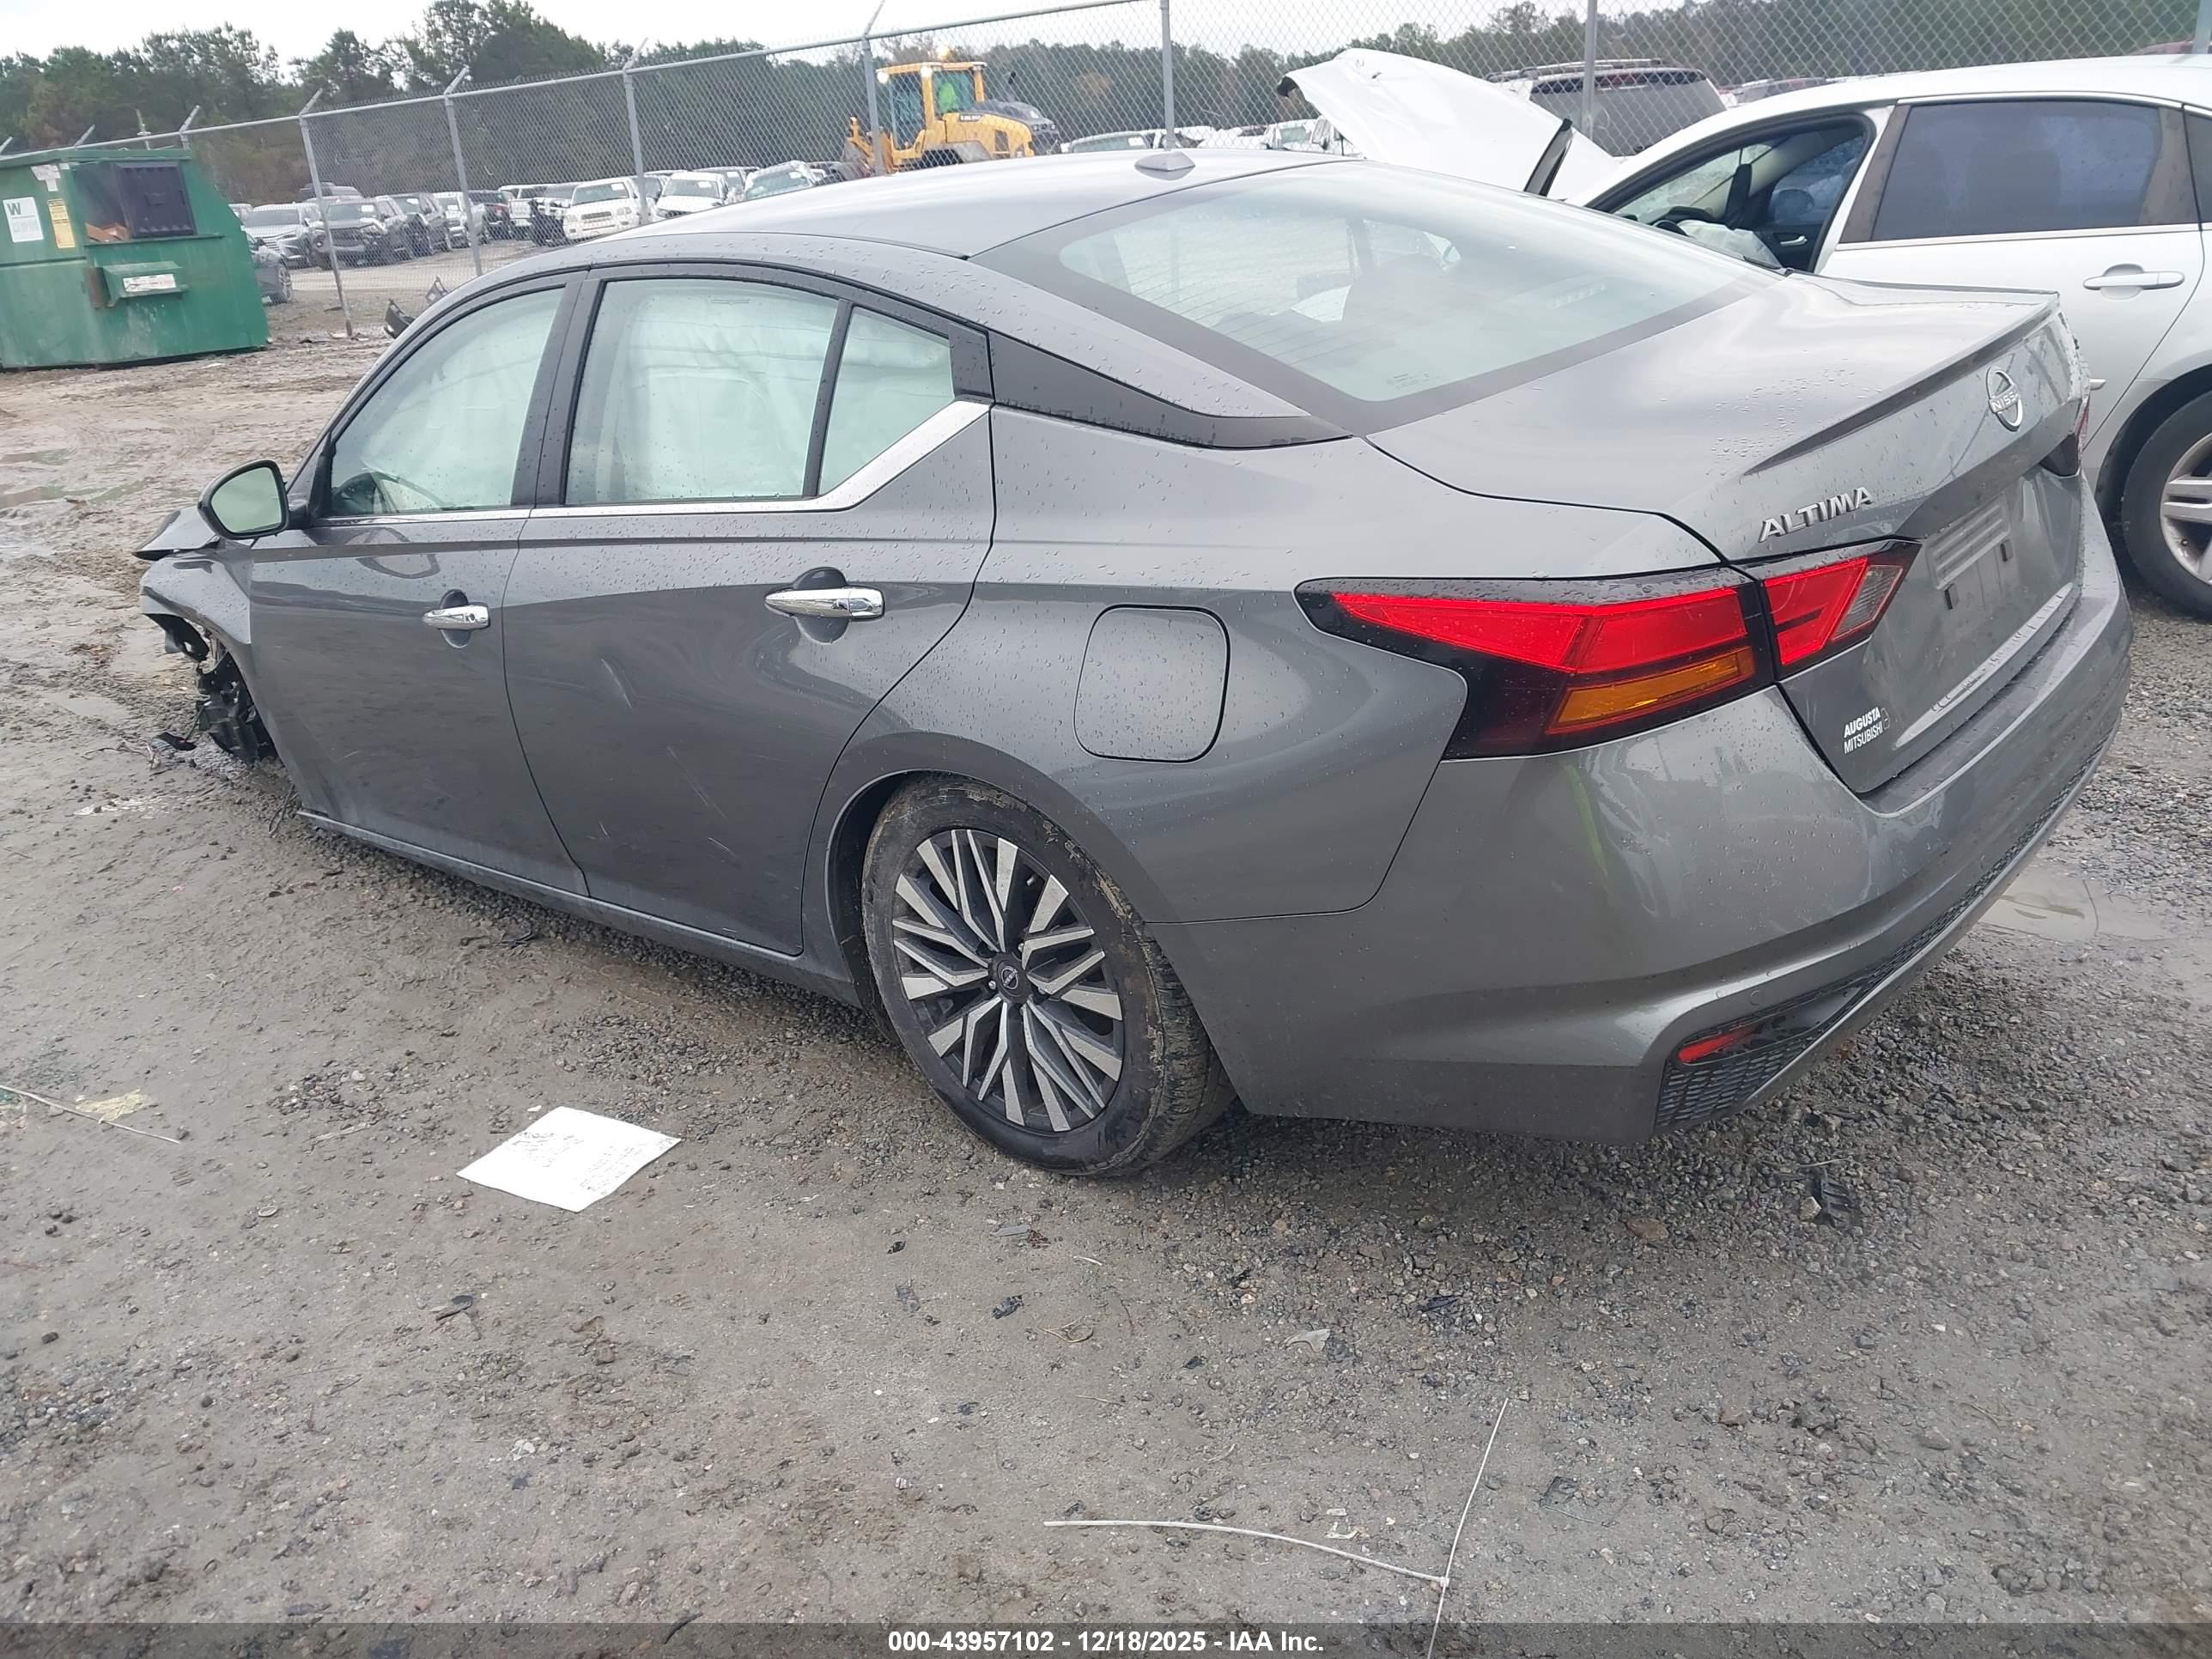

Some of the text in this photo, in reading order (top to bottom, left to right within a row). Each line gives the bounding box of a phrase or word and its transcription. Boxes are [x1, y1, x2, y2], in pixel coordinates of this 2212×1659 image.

[1759, 486, 1874, 543] ALTIMA
[1844, 707, 1881, 738] AUGUSTA
[1844, 720, 1883, 755] MITSUBISHI
